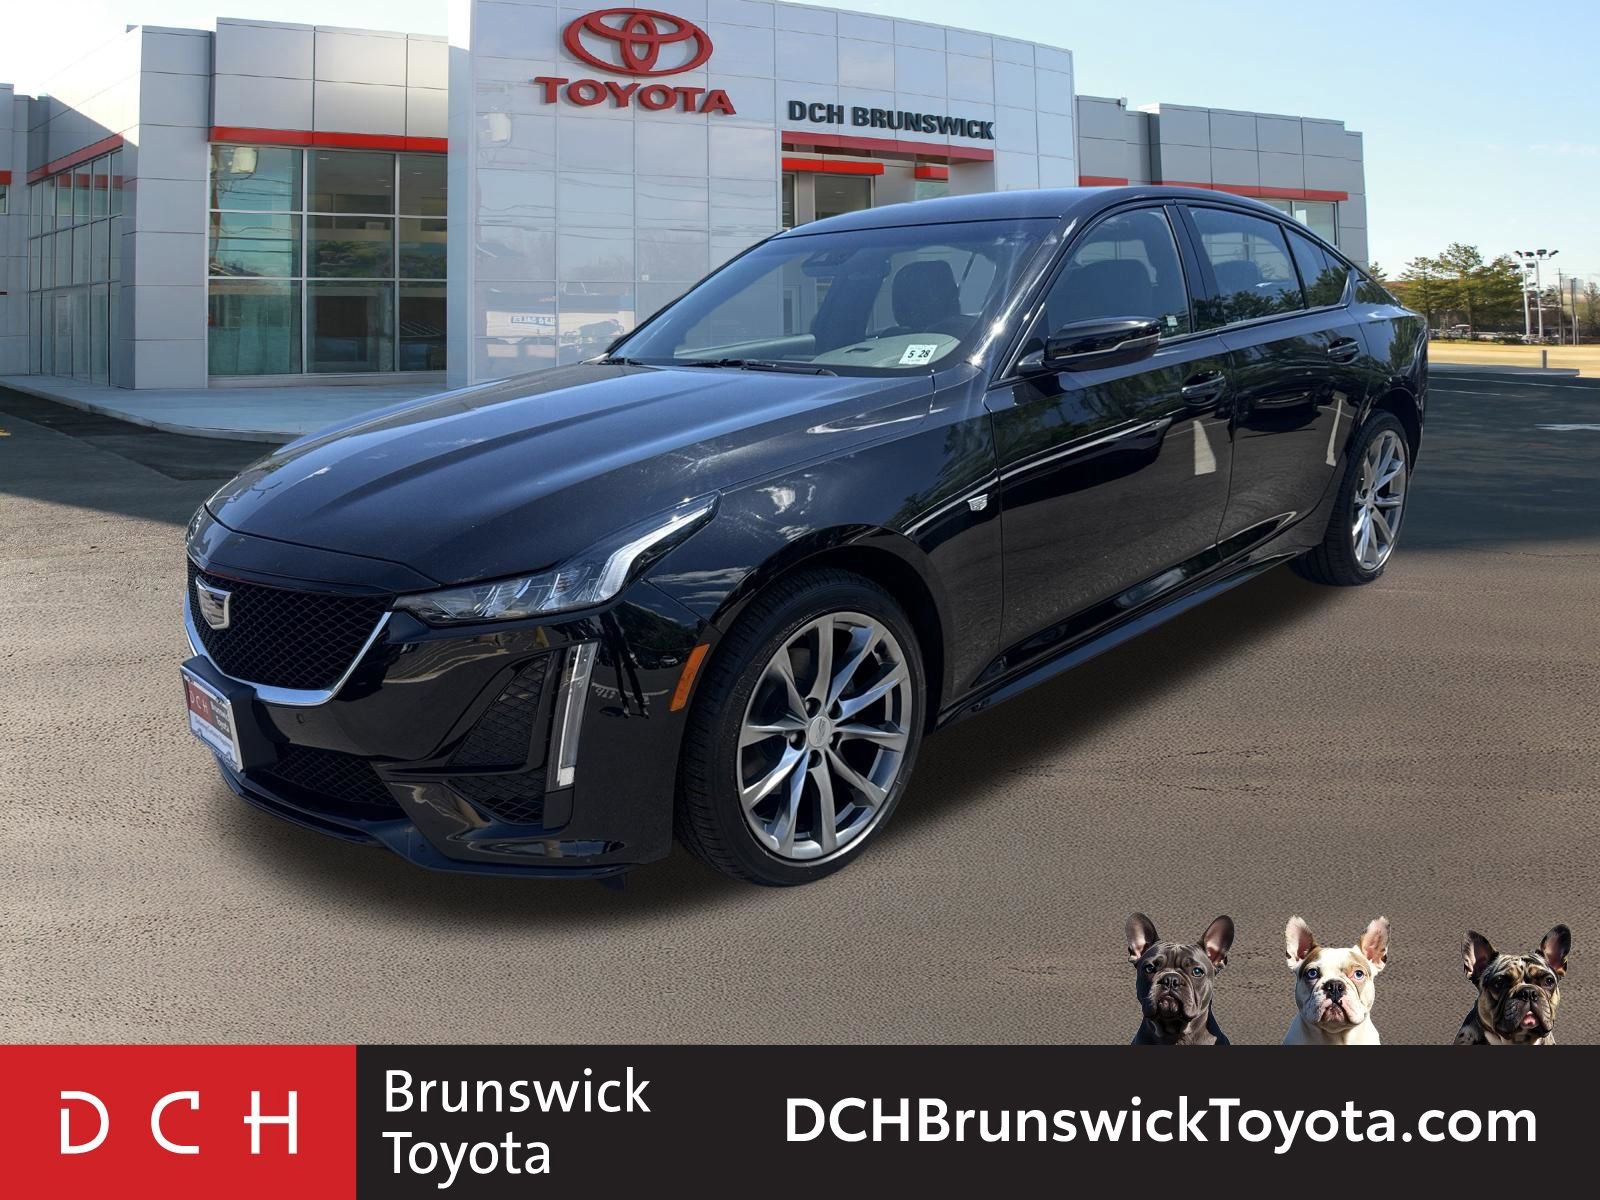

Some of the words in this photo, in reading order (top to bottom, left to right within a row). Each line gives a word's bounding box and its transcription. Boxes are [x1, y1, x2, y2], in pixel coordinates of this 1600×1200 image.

[534, 76, 737, 115] TOYOTA
[788, 100, 845, 125] DCH
[852, 106, 994, 140] BRUNSWICK
[907, 350, 916, 358] 5
[189, 690, 209, 714] DCH
